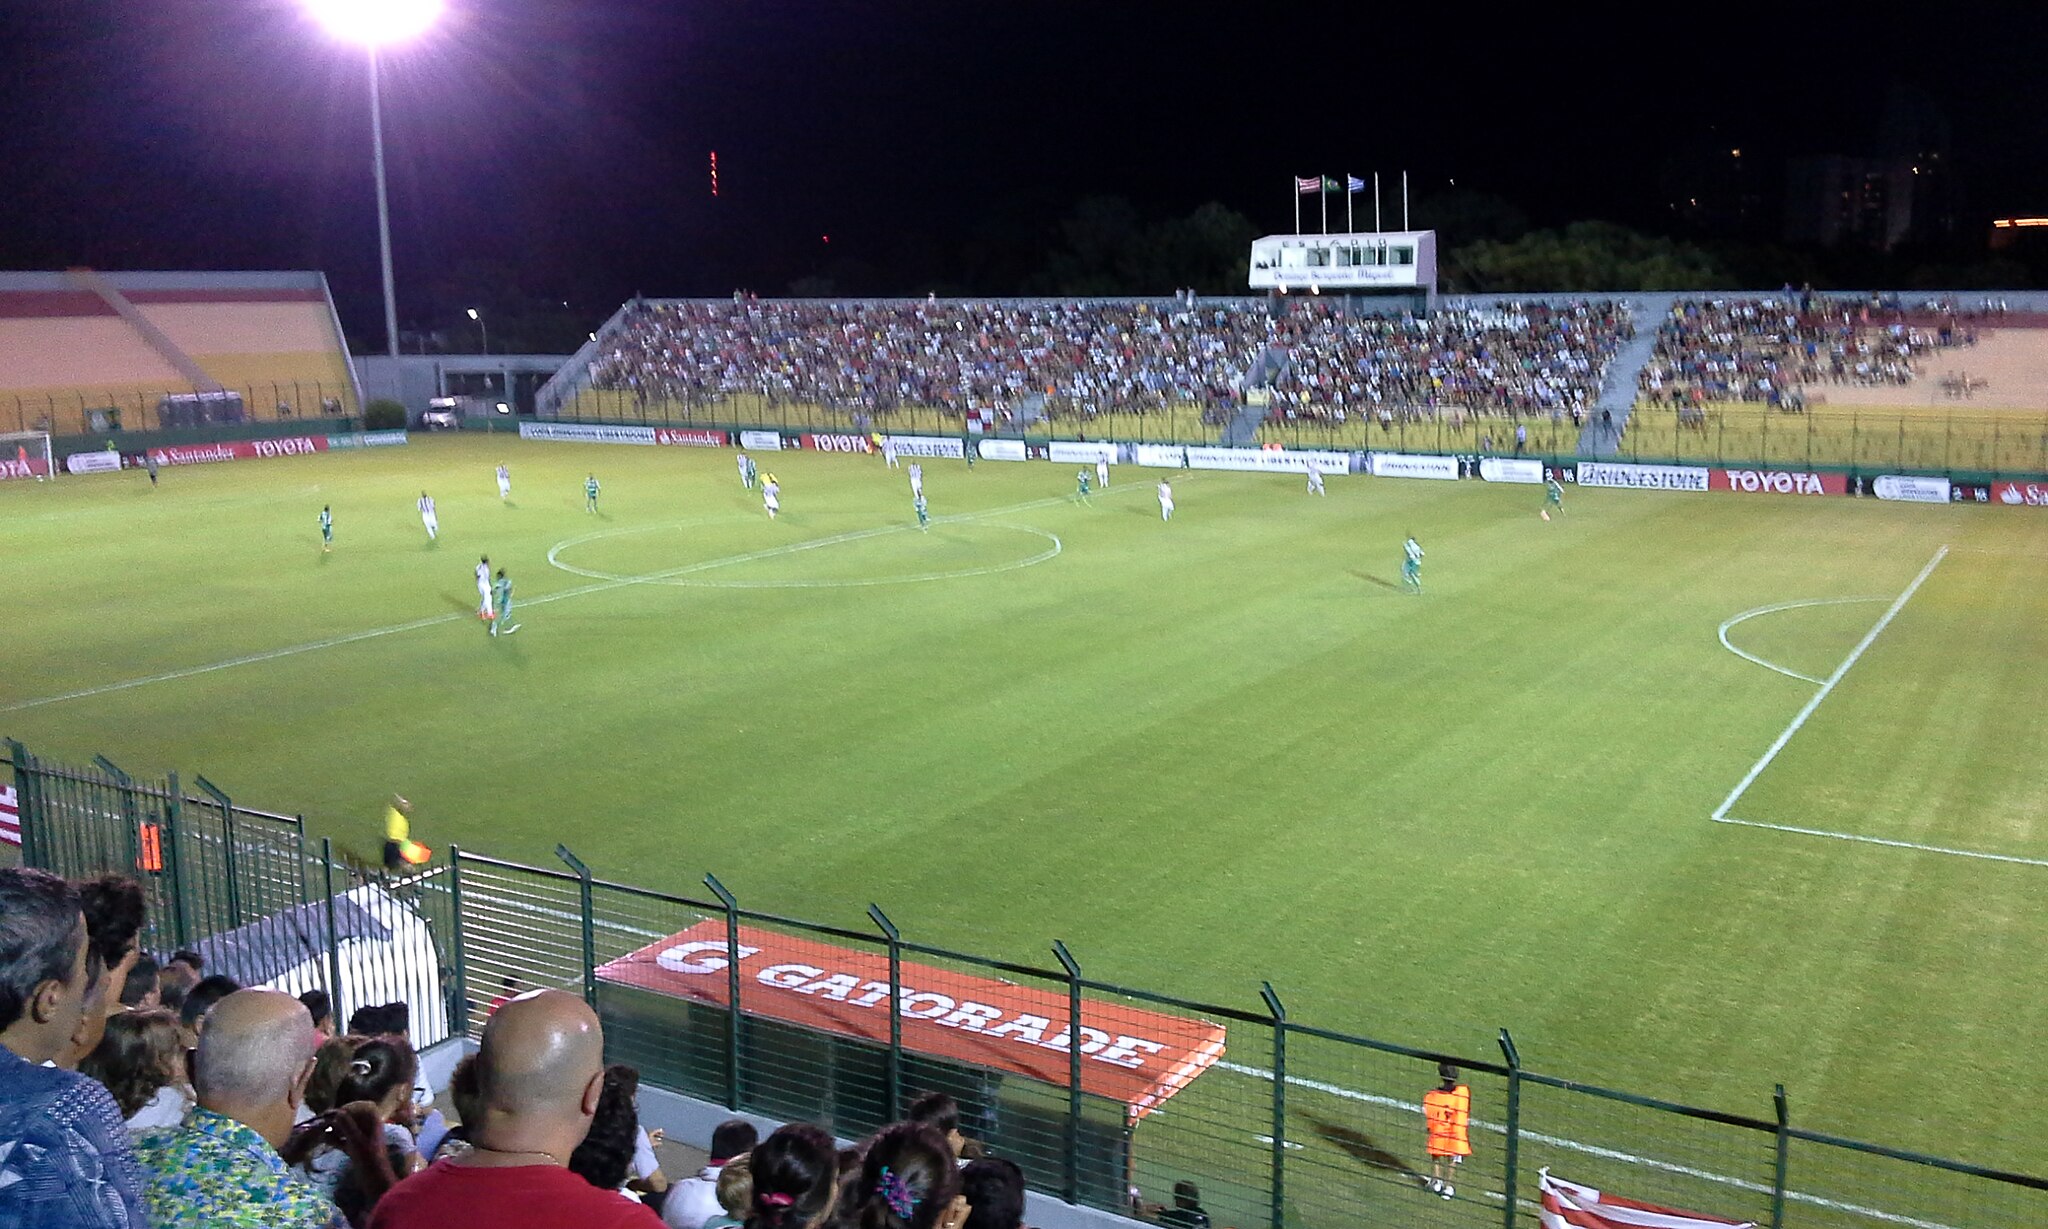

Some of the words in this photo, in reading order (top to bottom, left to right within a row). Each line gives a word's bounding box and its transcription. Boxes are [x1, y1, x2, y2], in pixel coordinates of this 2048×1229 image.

[252, 437, 317, 459] TOYOTA
[670, 429, 721, 448] Santander
[812, 434, 870, 454] TOYOTA
[169, 443, 236, 465] Santander
[1726, 469, 1824, 495] TOYOTA
[755, 963, 1170, 1069] GATORADE
